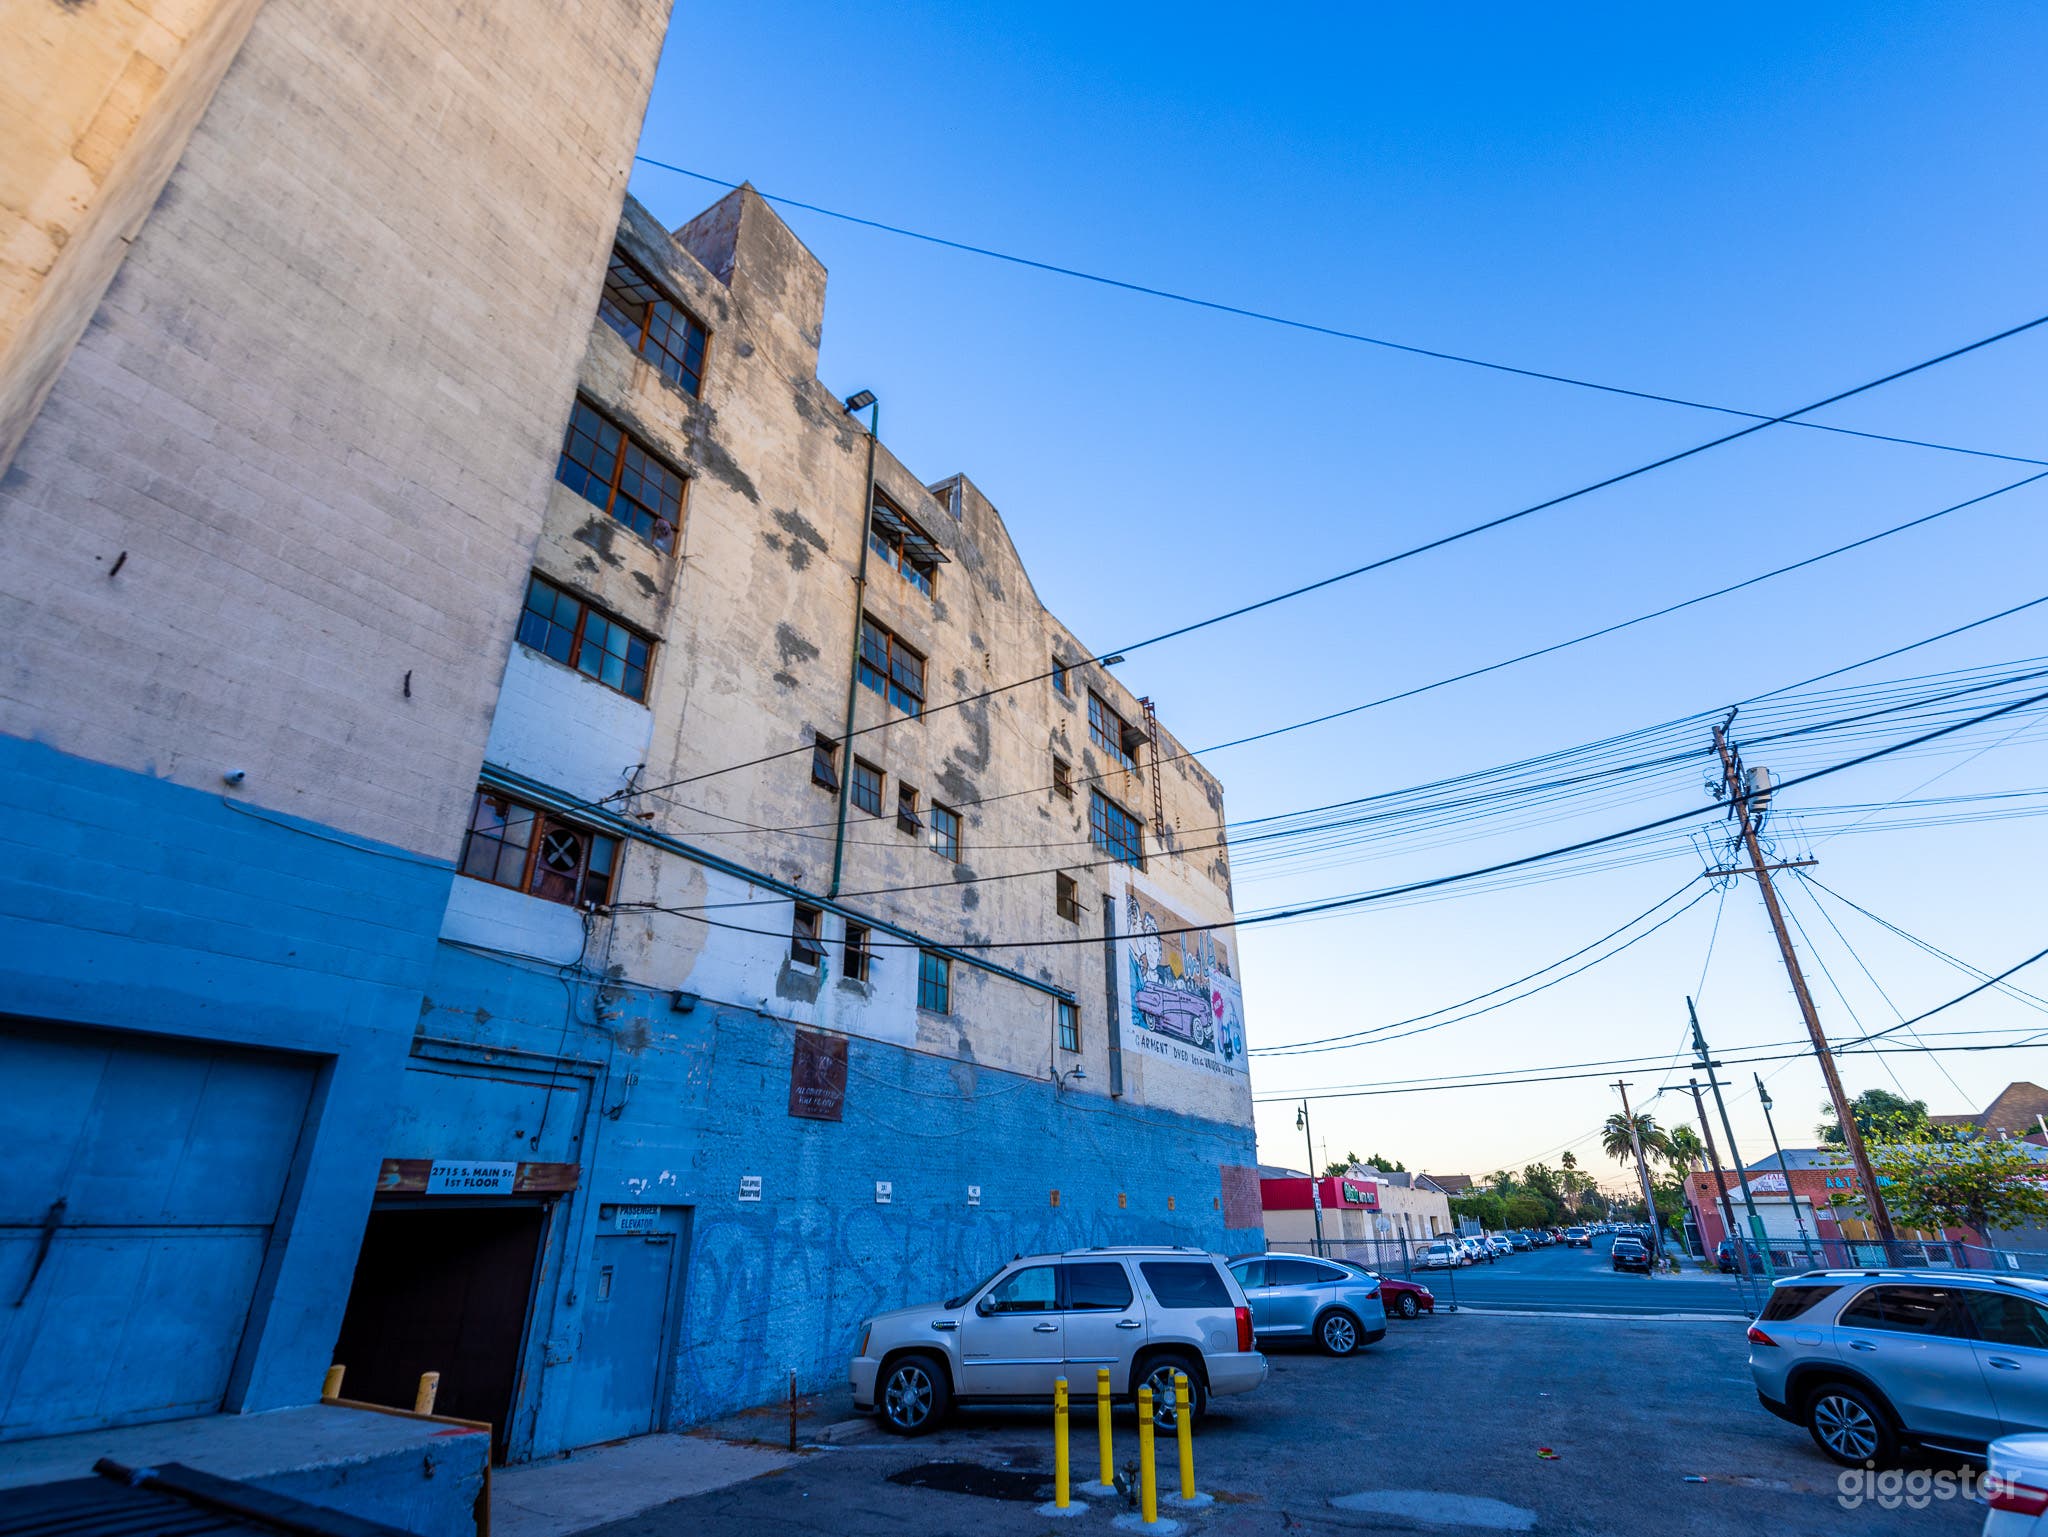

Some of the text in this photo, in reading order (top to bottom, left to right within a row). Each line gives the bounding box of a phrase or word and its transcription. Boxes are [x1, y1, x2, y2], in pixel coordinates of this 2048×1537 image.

[1135, 1034, 1168, 1055] GARMENT
[1173, 1047, 1189, 1062] DYED
[432, 1167, 458, 1176] 2715
[461, 1168, 469, 1177] S.
[472, 1168, 500, 1177] MAIN
[464, 1178, 499, 1188] FLOOR
